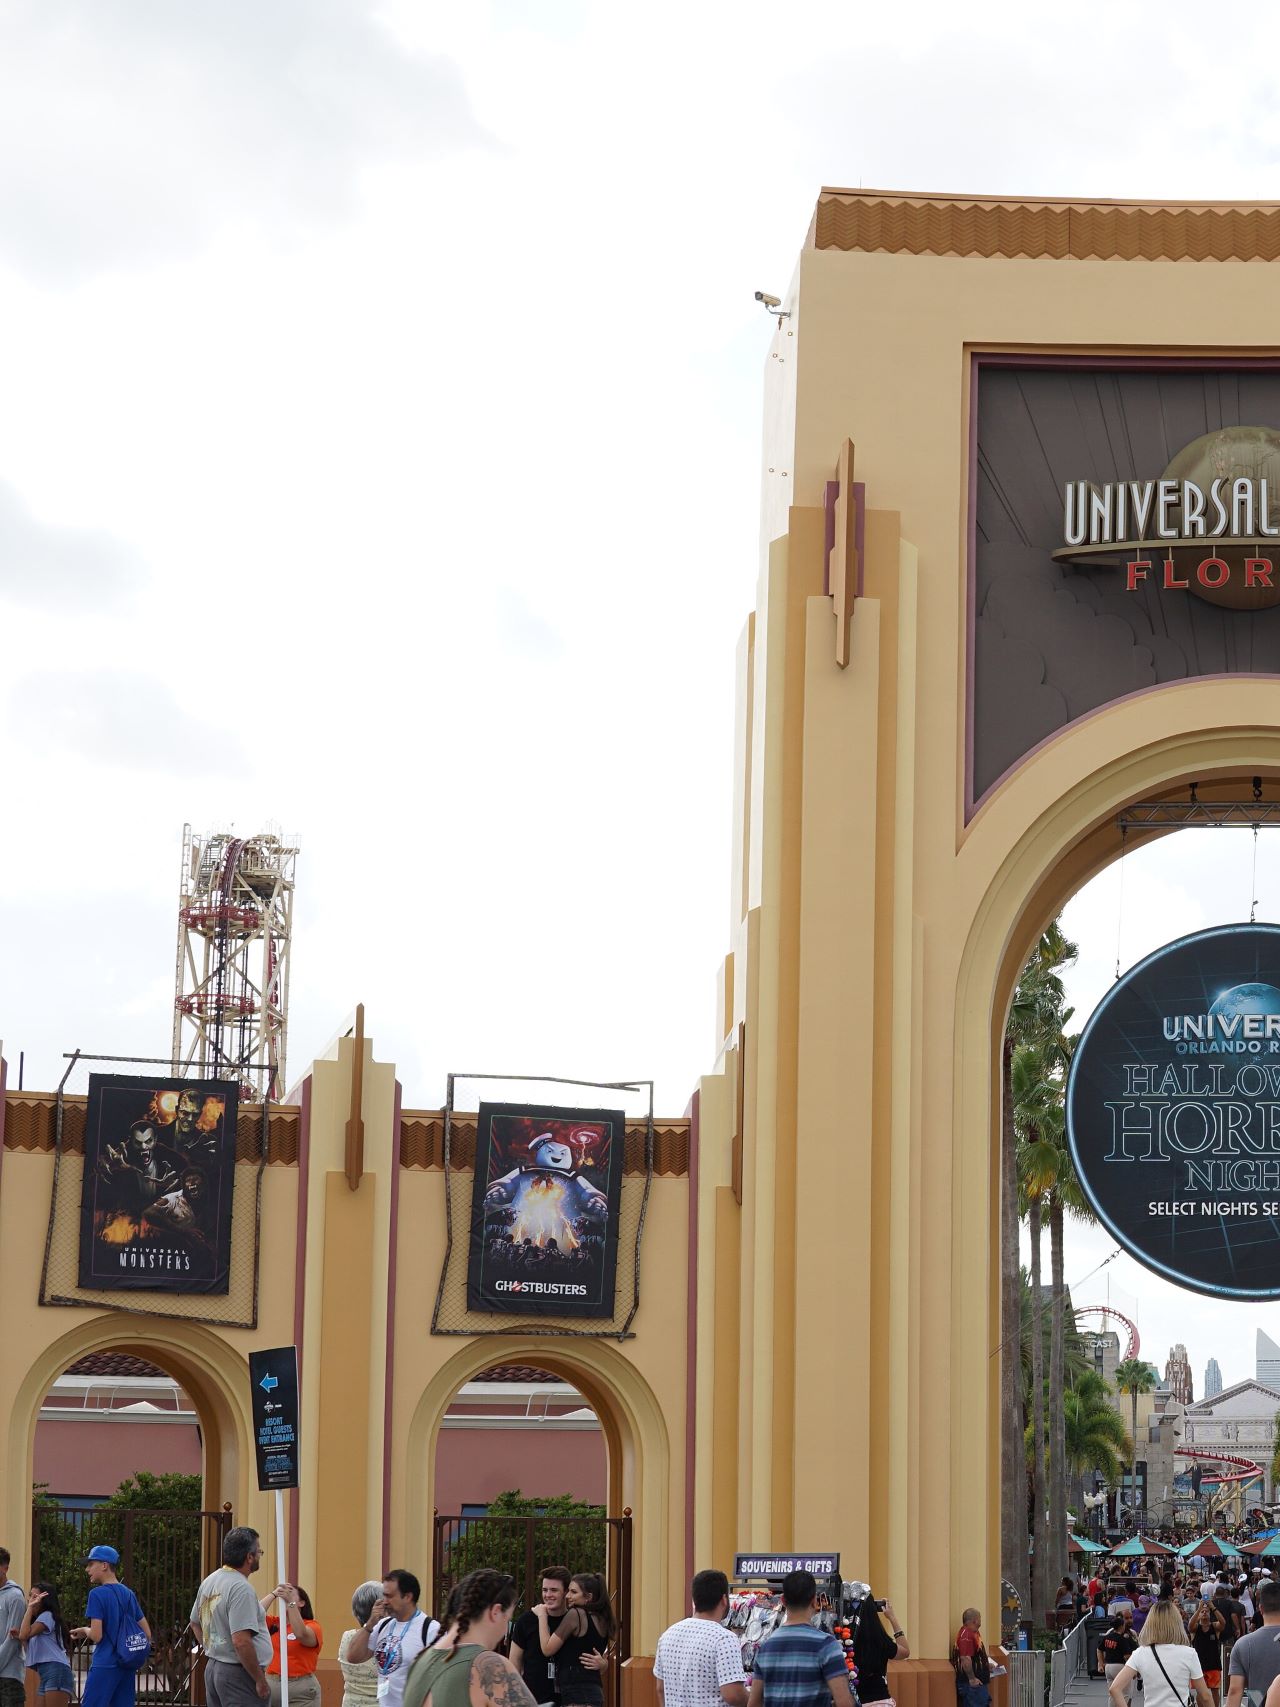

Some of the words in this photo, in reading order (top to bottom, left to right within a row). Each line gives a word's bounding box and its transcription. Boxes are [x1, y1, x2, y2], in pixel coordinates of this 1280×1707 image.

[1063, 477, 1280, 546] UNIVERSAL
[1175, 1041, 1262, 1055] ORLANDO
[1148, 1201, 1196, 1216] SELECT
[1201, 1201, 1258, 1216] NIGHTS
[124, 1247, 186, 1255] UNIVERSAL
[119, 1253, 190, 1270] MONSTERS
[495, 1280, 587, 1296] GHOSTBUSTERS
[741, 1560, 793, 1573] SOUVENIRS
[795, 1560, 802, 1571] &
[805, 1560, 833, 1573] GIFTS
